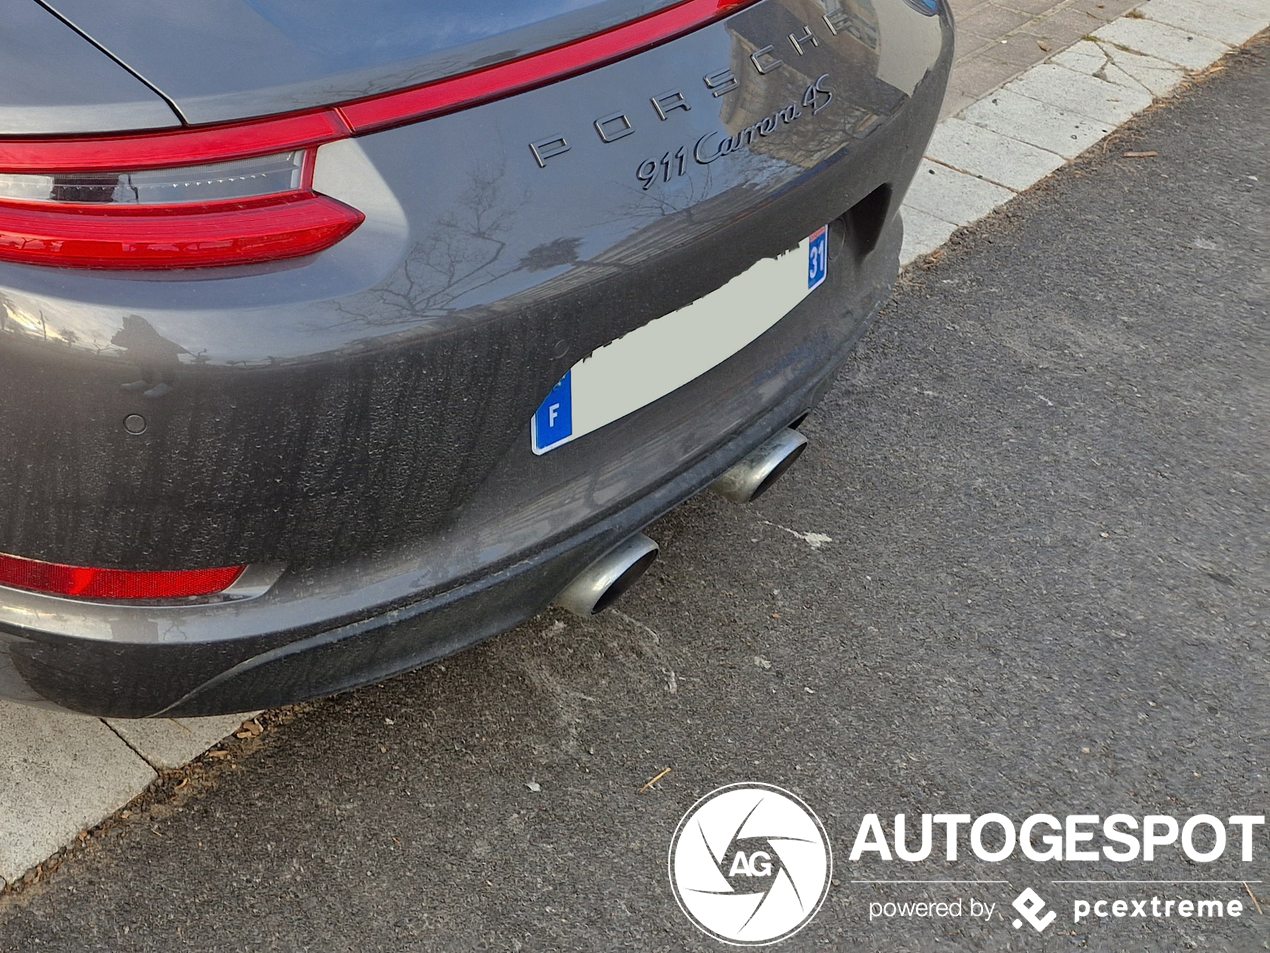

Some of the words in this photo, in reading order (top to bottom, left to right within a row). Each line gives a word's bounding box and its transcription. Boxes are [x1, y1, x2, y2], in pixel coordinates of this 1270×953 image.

[529, 8, 852, 168] PORSCHE
[636, 145, 688, 190] 911
[693, 104, 802, 165] Carrera
[802, 73, 833, 116] 4S
[810, 240, 824, 279] 31
[549, 402, 560, 428] F
